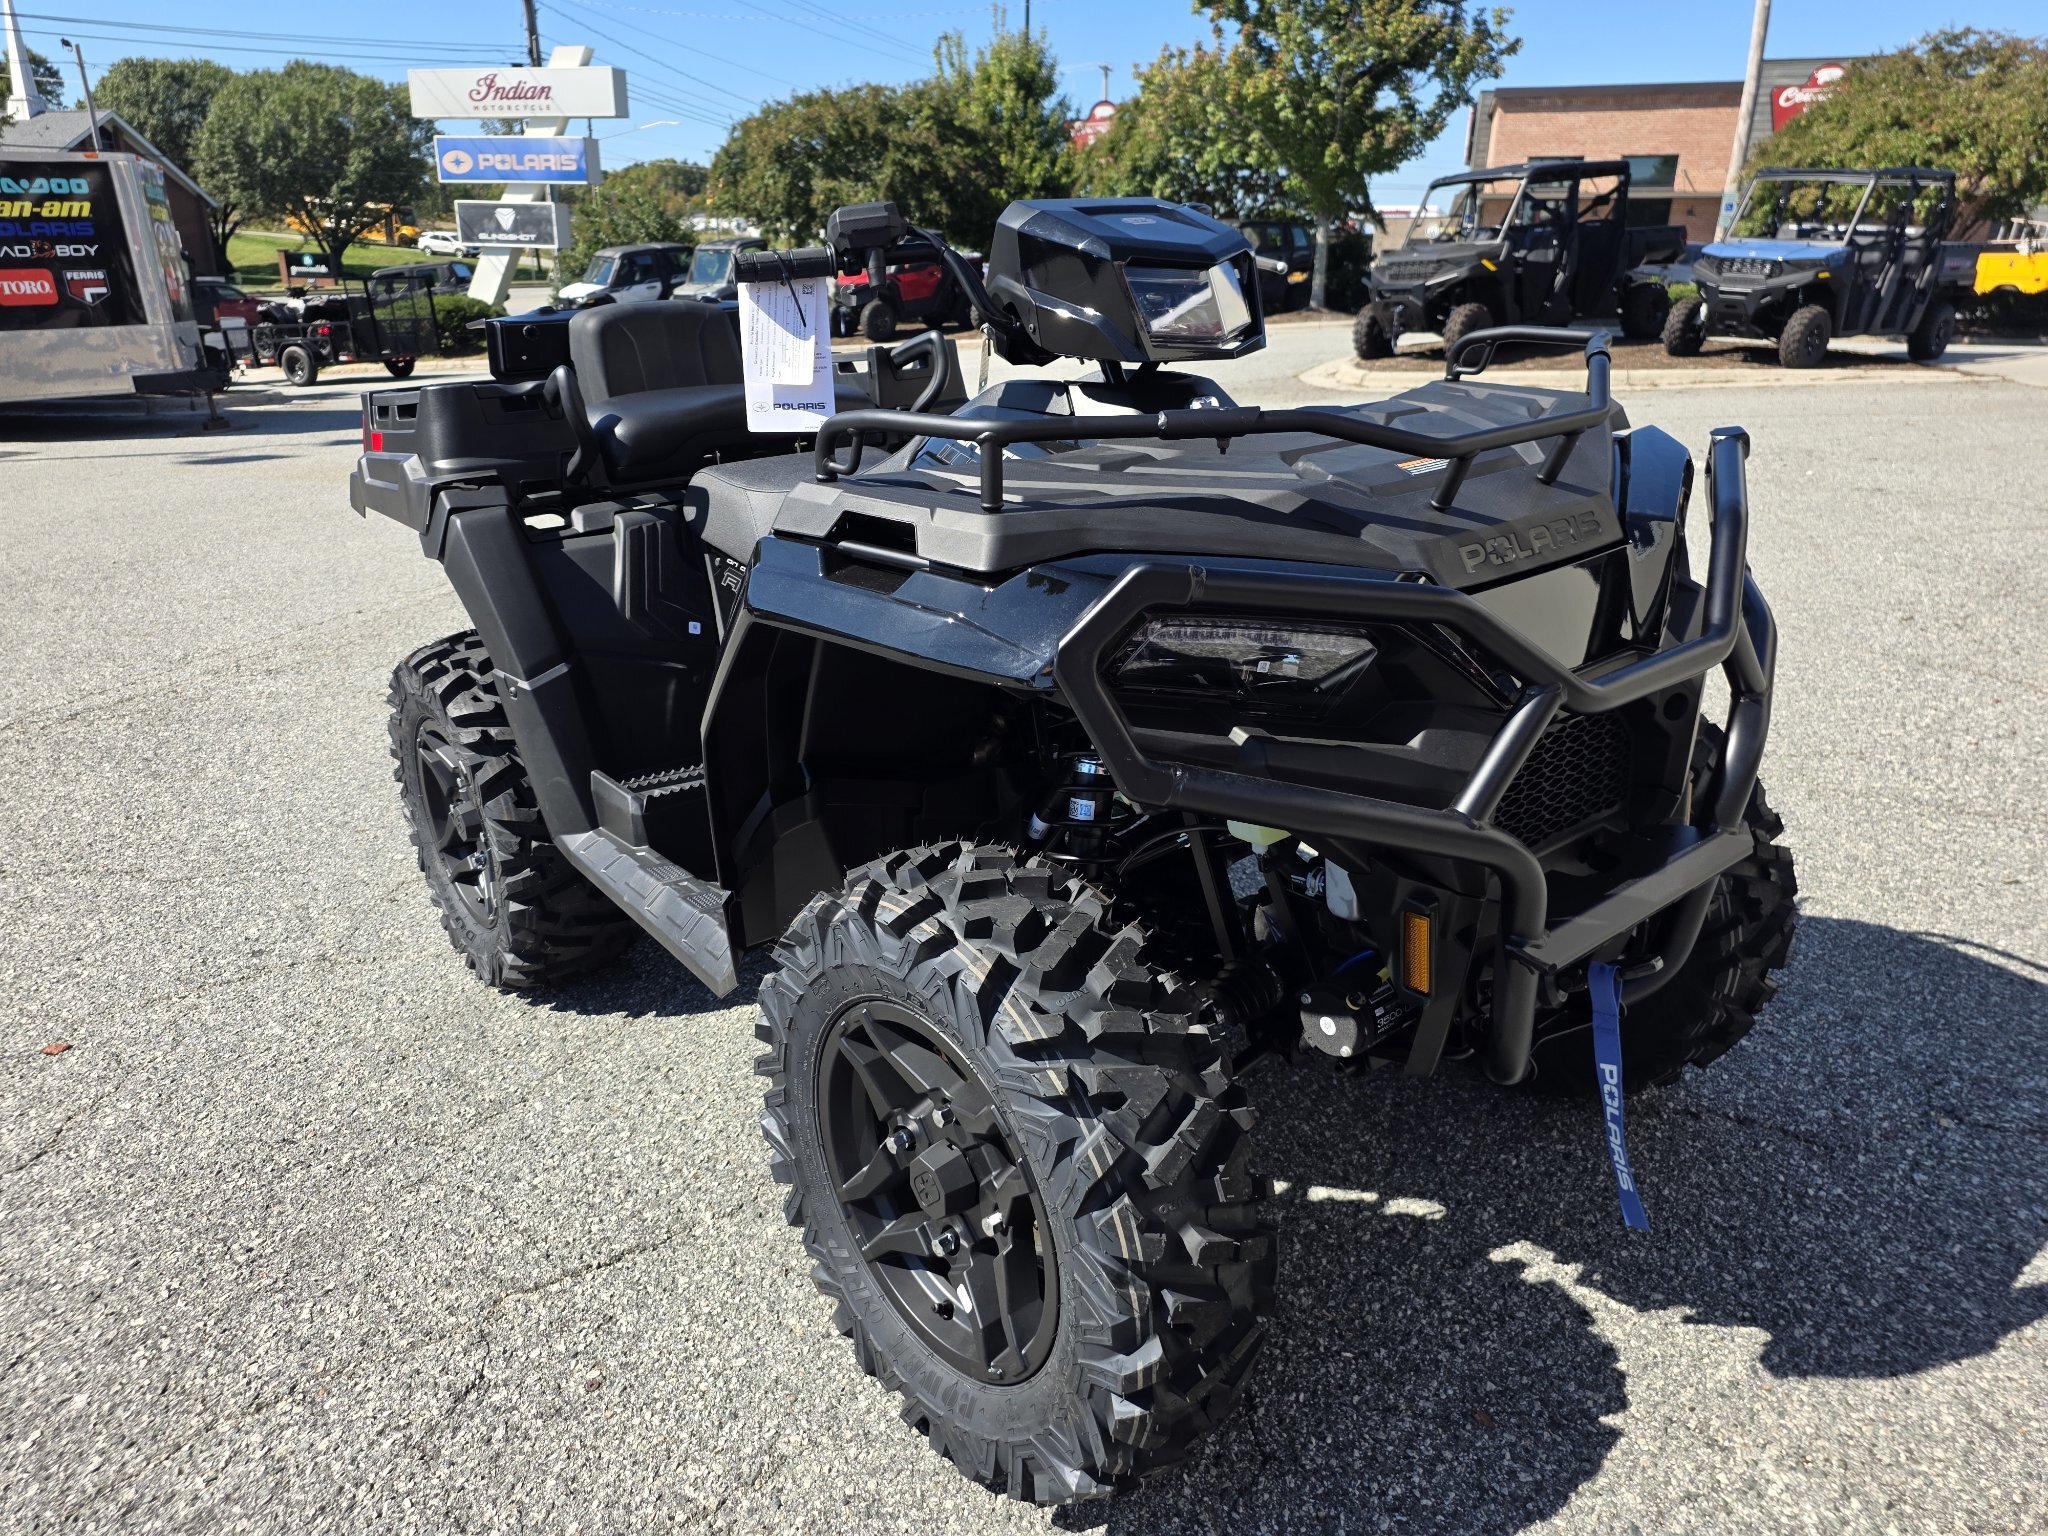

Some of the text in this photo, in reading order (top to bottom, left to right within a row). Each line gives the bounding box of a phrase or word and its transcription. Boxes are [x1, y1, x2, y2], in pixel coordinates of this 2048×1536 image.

[469, 73, 552, 101] Indian
[478, 154, 578, 171] POLARIS
[55, 245, 98, 256] BOY
[66, 271, 104, 280] FERRIS
[1, 280, 51, 295] TORO
[773, 402, 826, 411] POLARIS
[1458, 510, 1602, 574] POLARIS
[1600, 1062, 1633, 1193] POLARIS
